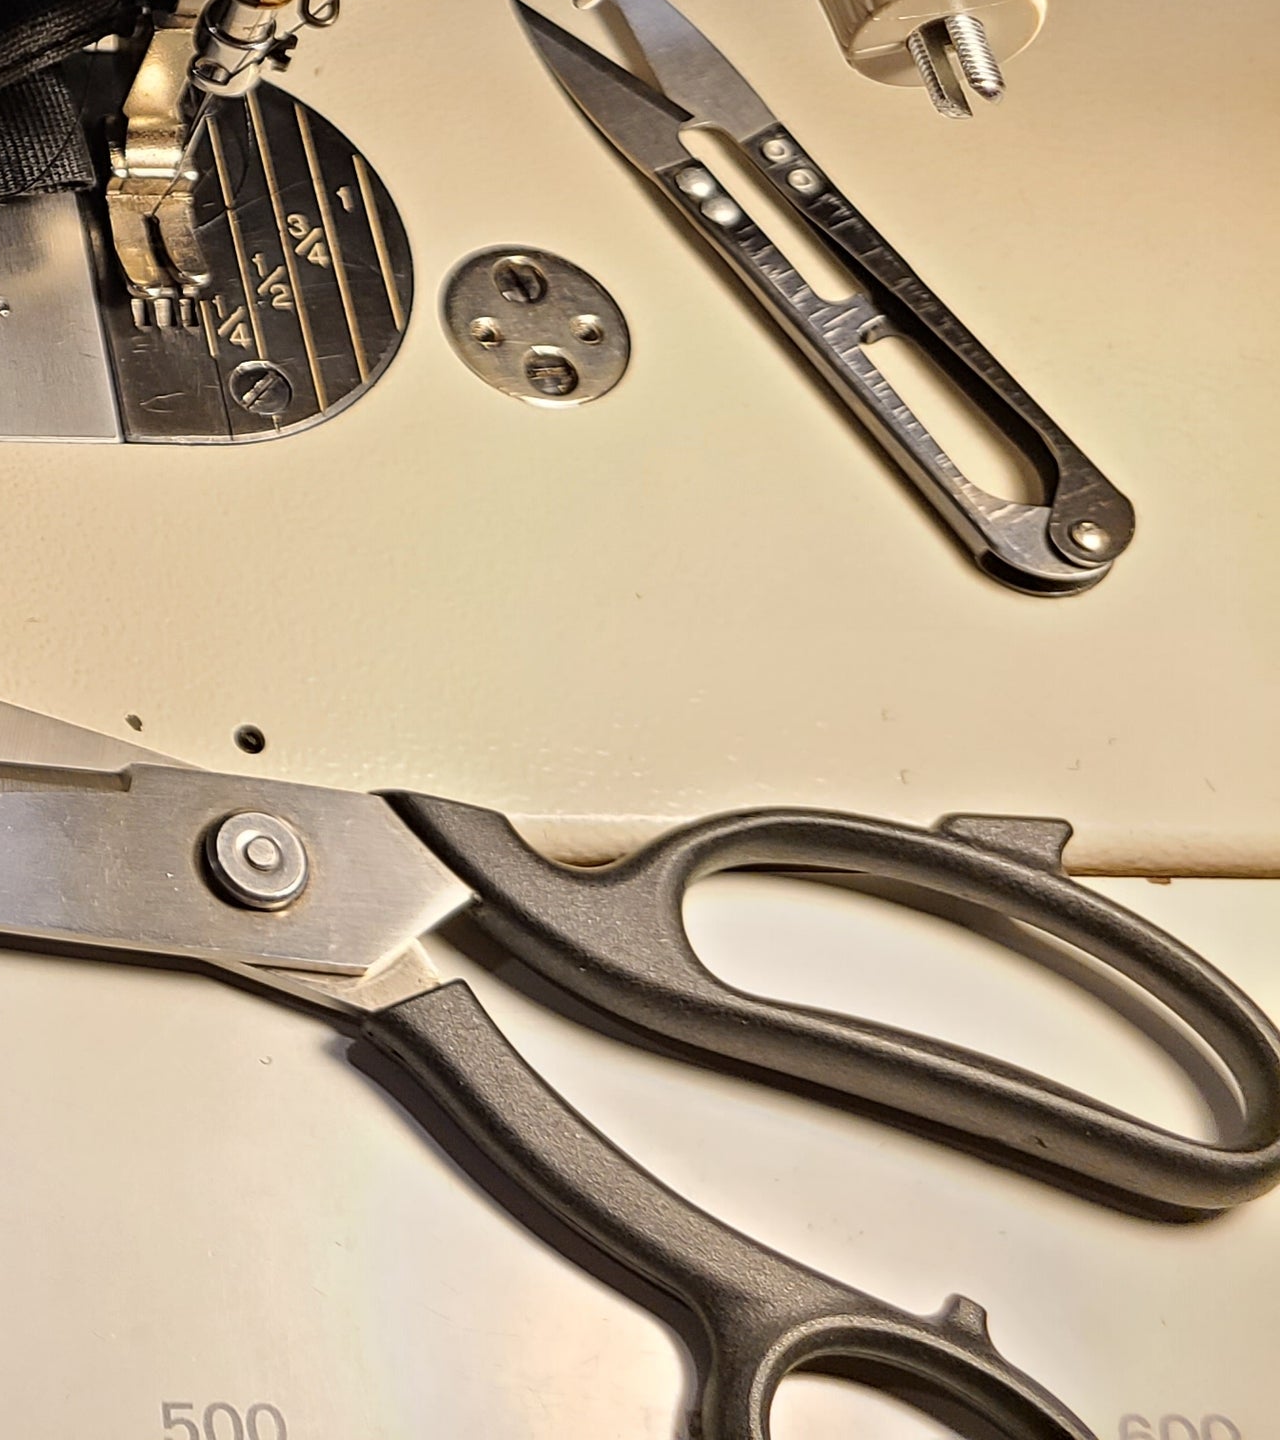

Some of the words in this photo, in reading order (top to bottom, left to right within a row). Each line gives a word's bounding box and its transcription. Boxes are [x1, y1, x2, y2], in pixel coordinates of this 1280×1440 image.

[212, 295, 252, 350] 1/4
[252, 252, 293, 311] 1/2
[287, 213, 330, 269] 3/4
[161, 1402, 288, 1440] 500
